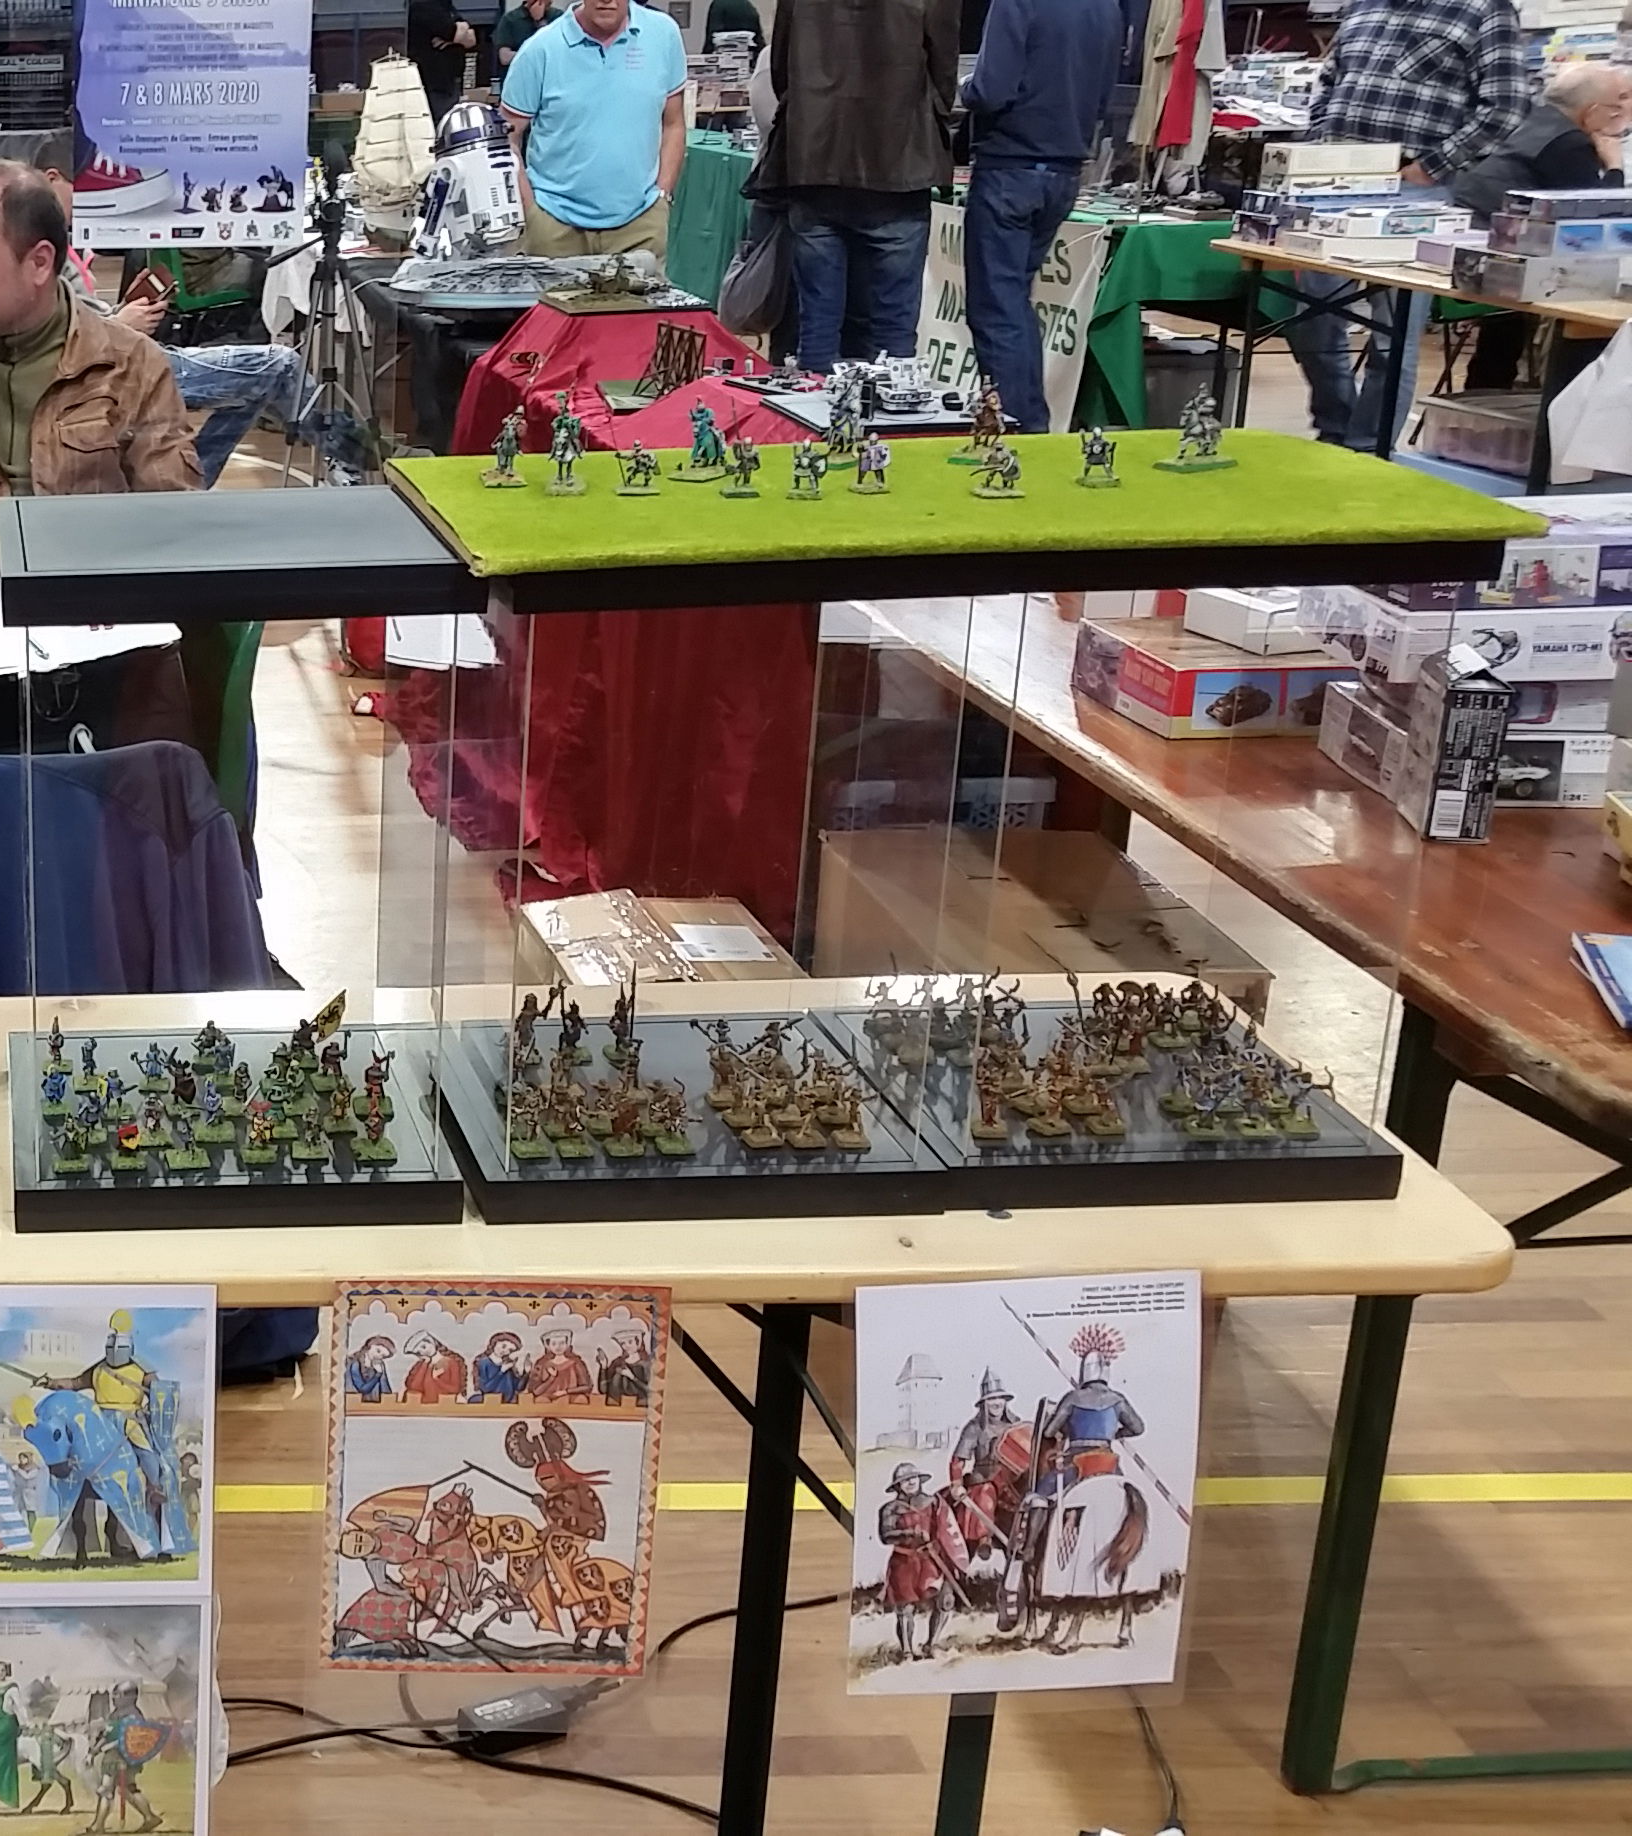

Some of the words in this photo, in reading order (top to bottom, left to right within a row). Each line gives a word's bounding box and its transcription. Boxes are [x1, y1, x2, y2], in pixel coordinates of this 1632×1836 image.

[120, 82, 131, 106] 7
[135, 83, 148, 106] &
[153, 82, 164, 106] 8
[169, 81, 213, 105] MARS
[218, 81, 260, 105] 2020
